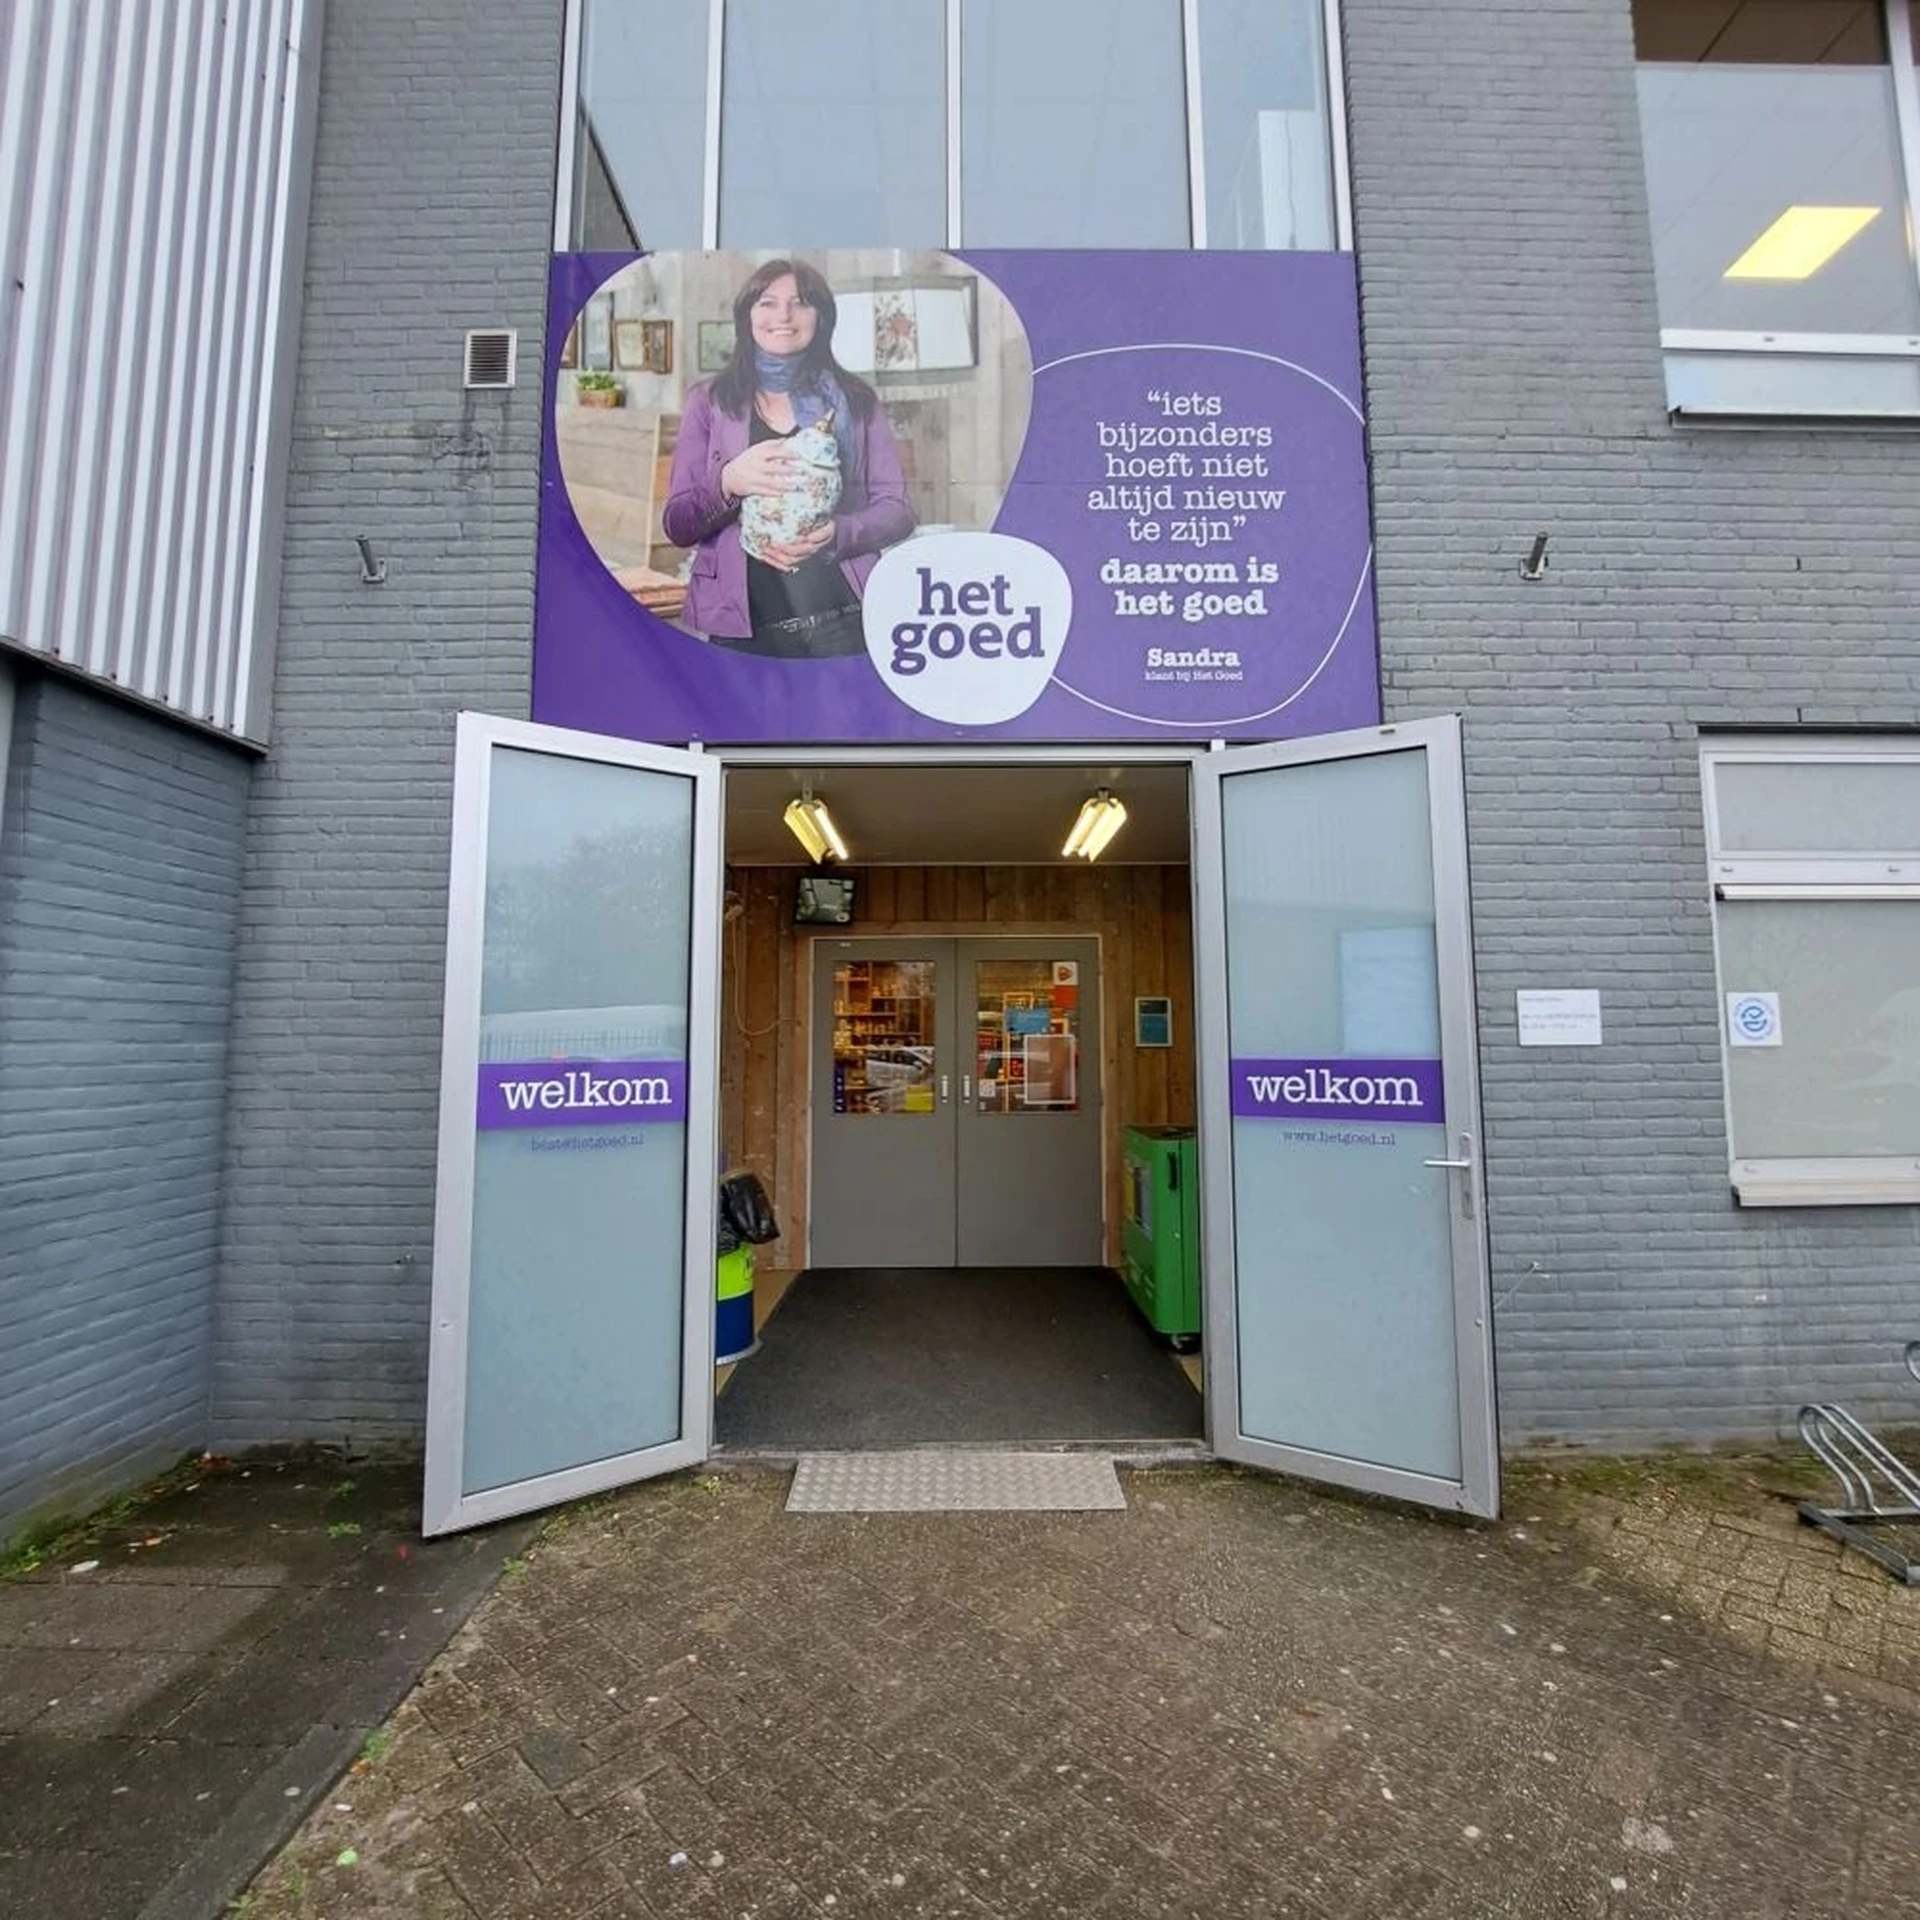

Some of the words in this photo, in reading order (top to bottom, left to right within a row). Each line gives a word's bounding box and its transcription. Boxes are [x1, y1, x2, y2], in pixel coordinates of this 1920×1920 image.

[1096, 422, 1273, 452] bijzonders
[1105, 453, 1193, 477] hoeft
[1201, 453, 1269, 477] niet
[1087, 485, 1175, 516] altijd
[1183, 486, 1286, 510] nieuw
[1127, 517, 1161, 541] te
[1100, 558, 1239, 584] daarom
[1247, 556, 1279, 584] is
[916, 567, 1014, 616] het
[1115, 590, 1174, 616] het
[1182, 590, 1268, 622] goed
[890, 606, 1045, 676] goed
[1147, 648, 1242, 667] Sandra
[1215, 671, 1243, 681] Goed
[499, 1072, 672, 1110] welkom
[1246, 1069, 1424, 1106] welkom
[1282, 1130, 1396, 1147] www.hetgoed.nl
